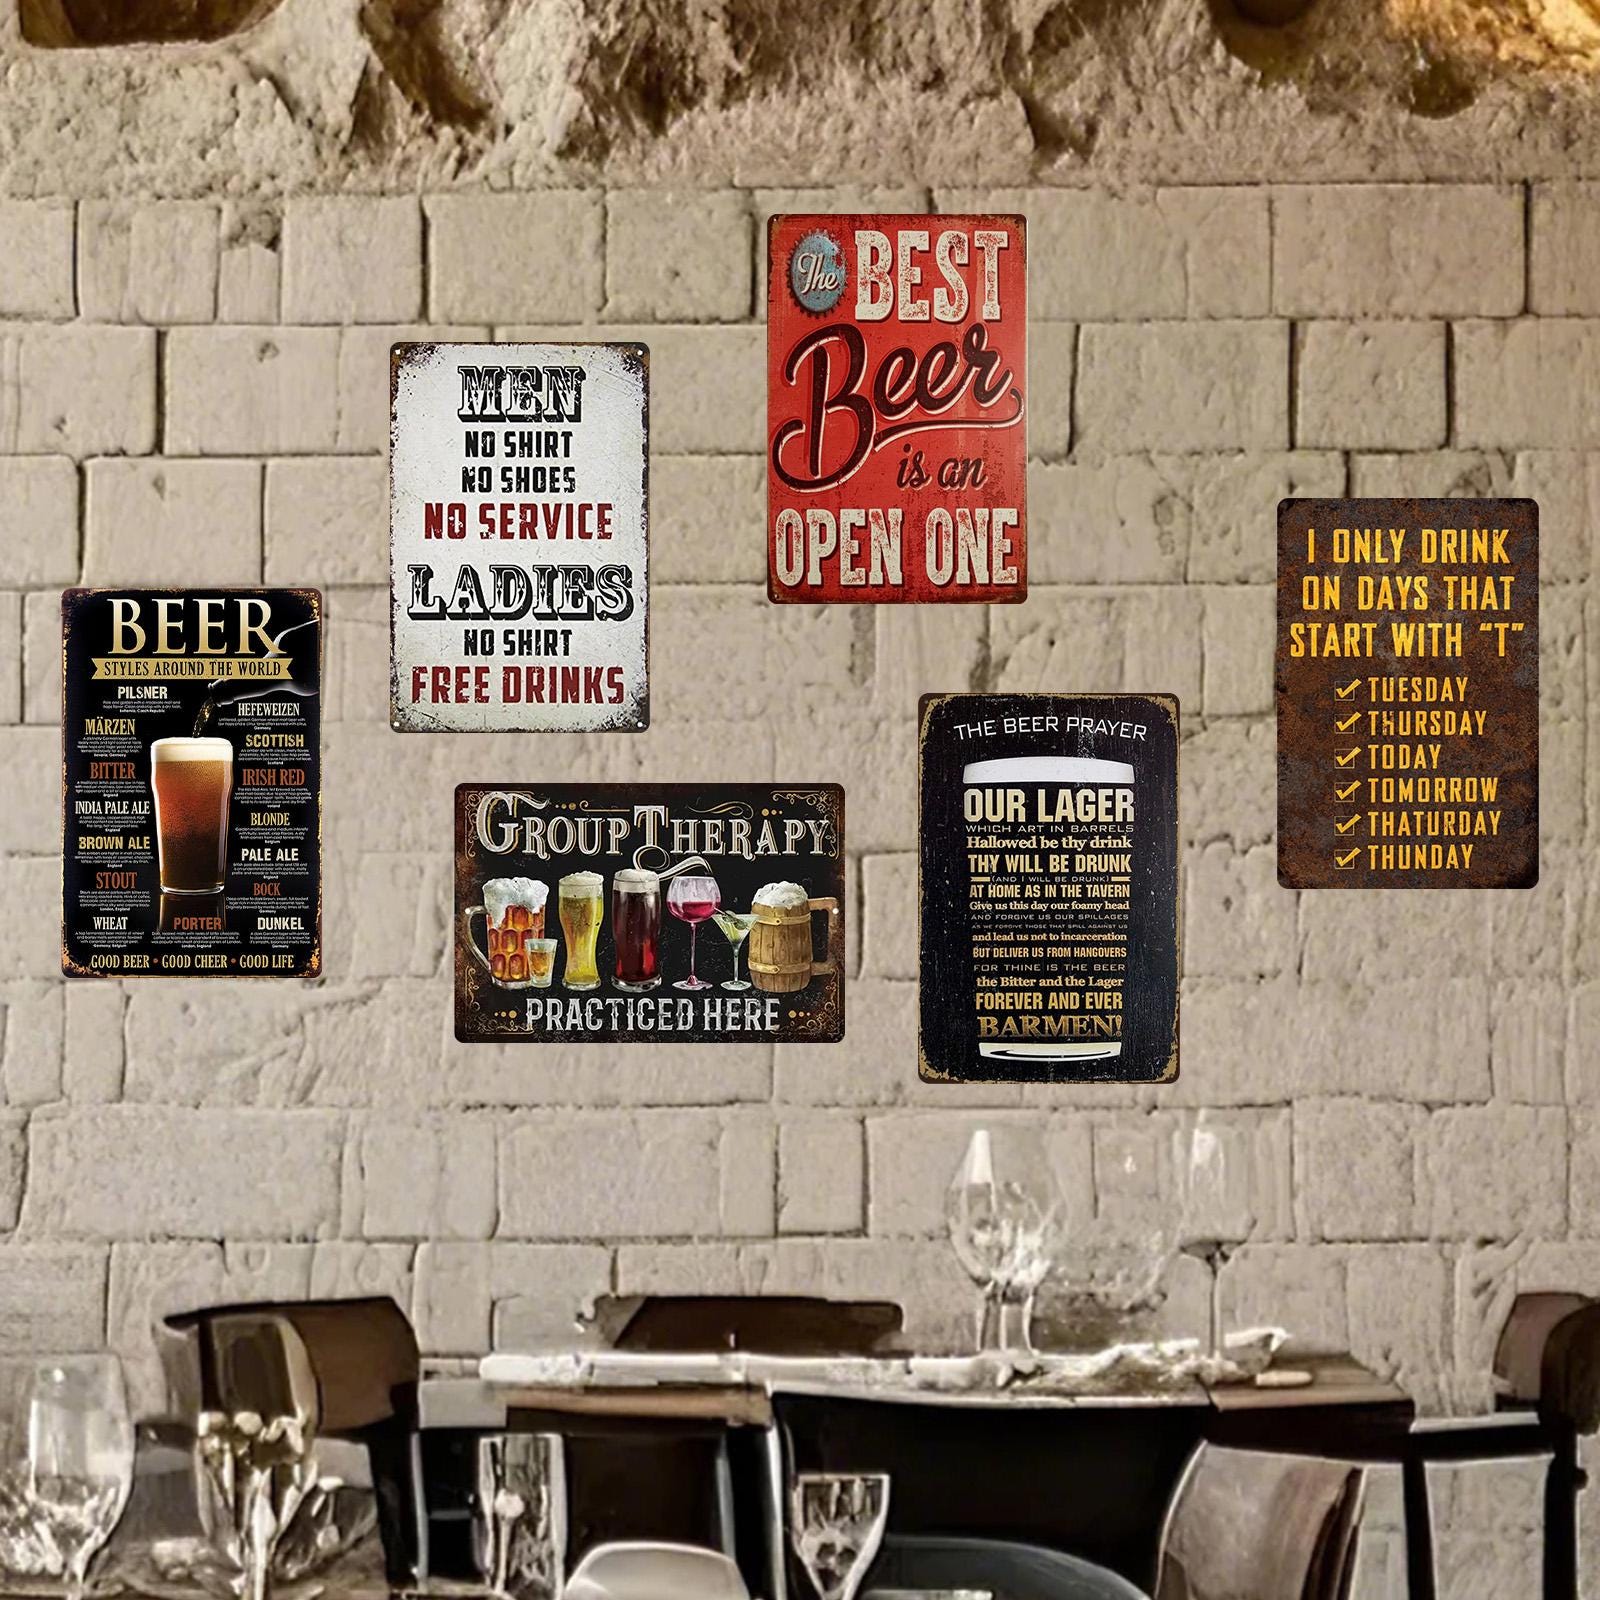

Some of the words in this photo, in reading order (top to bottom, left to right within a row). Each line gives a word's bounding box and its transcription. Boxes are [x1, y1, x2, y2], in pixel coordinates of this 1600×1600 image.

[797, 252, 838, 294] The
[855, 230, 1008, 322] BEST
[458, 366, 586, 422] MEN
[773, 323, 1024, 492] Beer
[466, 431, 495, 457] NO
[504, 431, 573, 458] SHIRT
[897, 444, 931, 489] is
[938, 458, 986, 489] an
[462, 466, 492, 492] NO
[501, 467, 575, 493] SHOES
[425, 503, 466, 539] NO
[479, 503, 612, 539] SERVICE
[776, 508, 904, 586] OPEN
[926, 508, 1018, 586] ONE
[1308, 529, 1314, 562] I
[1334, 529, 1405, 563] ONLY
[1422, 529, 1510, 563] DRINK
[407, 564, 634, 621] LADIES
[1303, 576, 1340, 610] ON
[1358, 576, 1428, 610] DAYS
[1444, 576, 1514, 610] THAT
[107, 598, 287, 654] BEER
[464, 629, 494, 656] NO
[504, 630, 572, 656] SHIRT
[1290, 623, 1377, 657] START
[1392, 623, 1462, 656] WITH
[104, 662, 148, 676] STYLES
[155, 662, 204, 676] AROUND
[210, 662, 232, 676] THE
[238, 662, 280, 676] WORLD
[118, 686, 167, 699] PILSNER
[412, 666, 490, 704] FREE
[503, 666, 624, 704] DRINKS
[1368, 677, 1468, 702] TUESDAY
[238, 703, 299, 716] HEFEWEIZEN
[86, 716, 135, 735] MÄRZEN
[954, 720, 996, 740] THE
[1004, 716, 1058, 734] BEER
[1067, 717, 1147, 742] PRAYER
[1368, 710, 1486, 735] THURSDAY
[246, 734, 304, 747] SCOTTISH
[1368, 744, 1441, 769] TODAY
[90, 764, 136, 779] BITTER
[242, 769, 276, 785] IRISH
[280, 769, 304, 785] RED
[1368, 778, 1498, 802] TOMORROW
[76, 801, 102, 814] INDIA
[105, 801, 129, 814] PALE
[131, 801, 150, 814] ALE
[964, 789, 1025, 822] OUR
[1038, 789, 1134, 822] LAGER
[251, 813, 290, 826] BLONDE
[476, 792, 630, 860] GROUP
[633, 805, 829, 863] THERAPY
[1368, 811, 1501, 836] THATURDAY
[79, 836, 123, 849] BROWN
[128, 836, 150, 849] ALE
[967, 836, 1037, 848] Hallowed
[1040, 836, 1058, 848] be
[1061, 836, 1087, 850] thy
[1090, 836, 1133, 848] drink
[242, 848, 271, 861] PALE
[276, 848, 298, 861] ALE
[968, 855, 999, 872] THY
[1005, 855, 1043, 872] WILL
[1050, 855, 1069, 872] BE
[1075, 854, 1132, 872] DRUNK
[1368, 844, 1473, 870] THUNDAY
[96, 872, 137, 889] STOUT
[254, 883, 280, 896] BOCK
[970, 885, 984, 897] AT
[988, 884, 1020, 897] HOME
[1025, 885, 1040, 897] AS
[1045, 885, 1056, 897] IN
[1060, 885, 1082, 897] THE
[1086, 884, 1130, 897] TAVERN
[970, 901, 992, 910] Give
[1009, 901, 1028, 910] this
[1031, 901, 1049, 911] day
[1071, 901, 1102, 911] foamy
[1104, 901, 1130, 910] head
[93, 917, 128, 930] WHEAT
[174, 918, 222, 930] PORTER
[258, 917, 304, 930] DUNKEL
[972, 932, 991, 941] and
[993, 932, 1014, 941] lead
[1061, 932, 1127, 940] incarceration
[91, 954, 119, 968] GOOD
[124, 954, 149, 968] BEER
[162, 954, 191, 968] GOOD
[195, 954, 227, 968] CHEER
[240, 954, 269, 968] GOOD
[273, 954, 294, 968] LIFE
[973, 947, 990, 958] BUT
[993, 948, 1028, 957] DELIVER
[1032, 948, 1044, 957] US
[1047, 947, 1071, 957] FROM
[1074, 947, 1126, 957] HANGOVERS
[976, 976, 997, 986] the
[1000, 976, 1036, 986] Bitter
[1039, 976, 1063, 986] and
[1065, 976, 1085, 986] the
[1088, 976, 1124, 989] Lager
[976, 992, 1042, 1009] FOREVER
[1048, 992, 1079, 1009] AND
[1084, 992, 1122, 1009] EVER
[526, 998, 692, 1031] PRACTICED
[703, 998, 780, 1031] HERE
[977, 1014, 1122, 1037] BARMEN!
